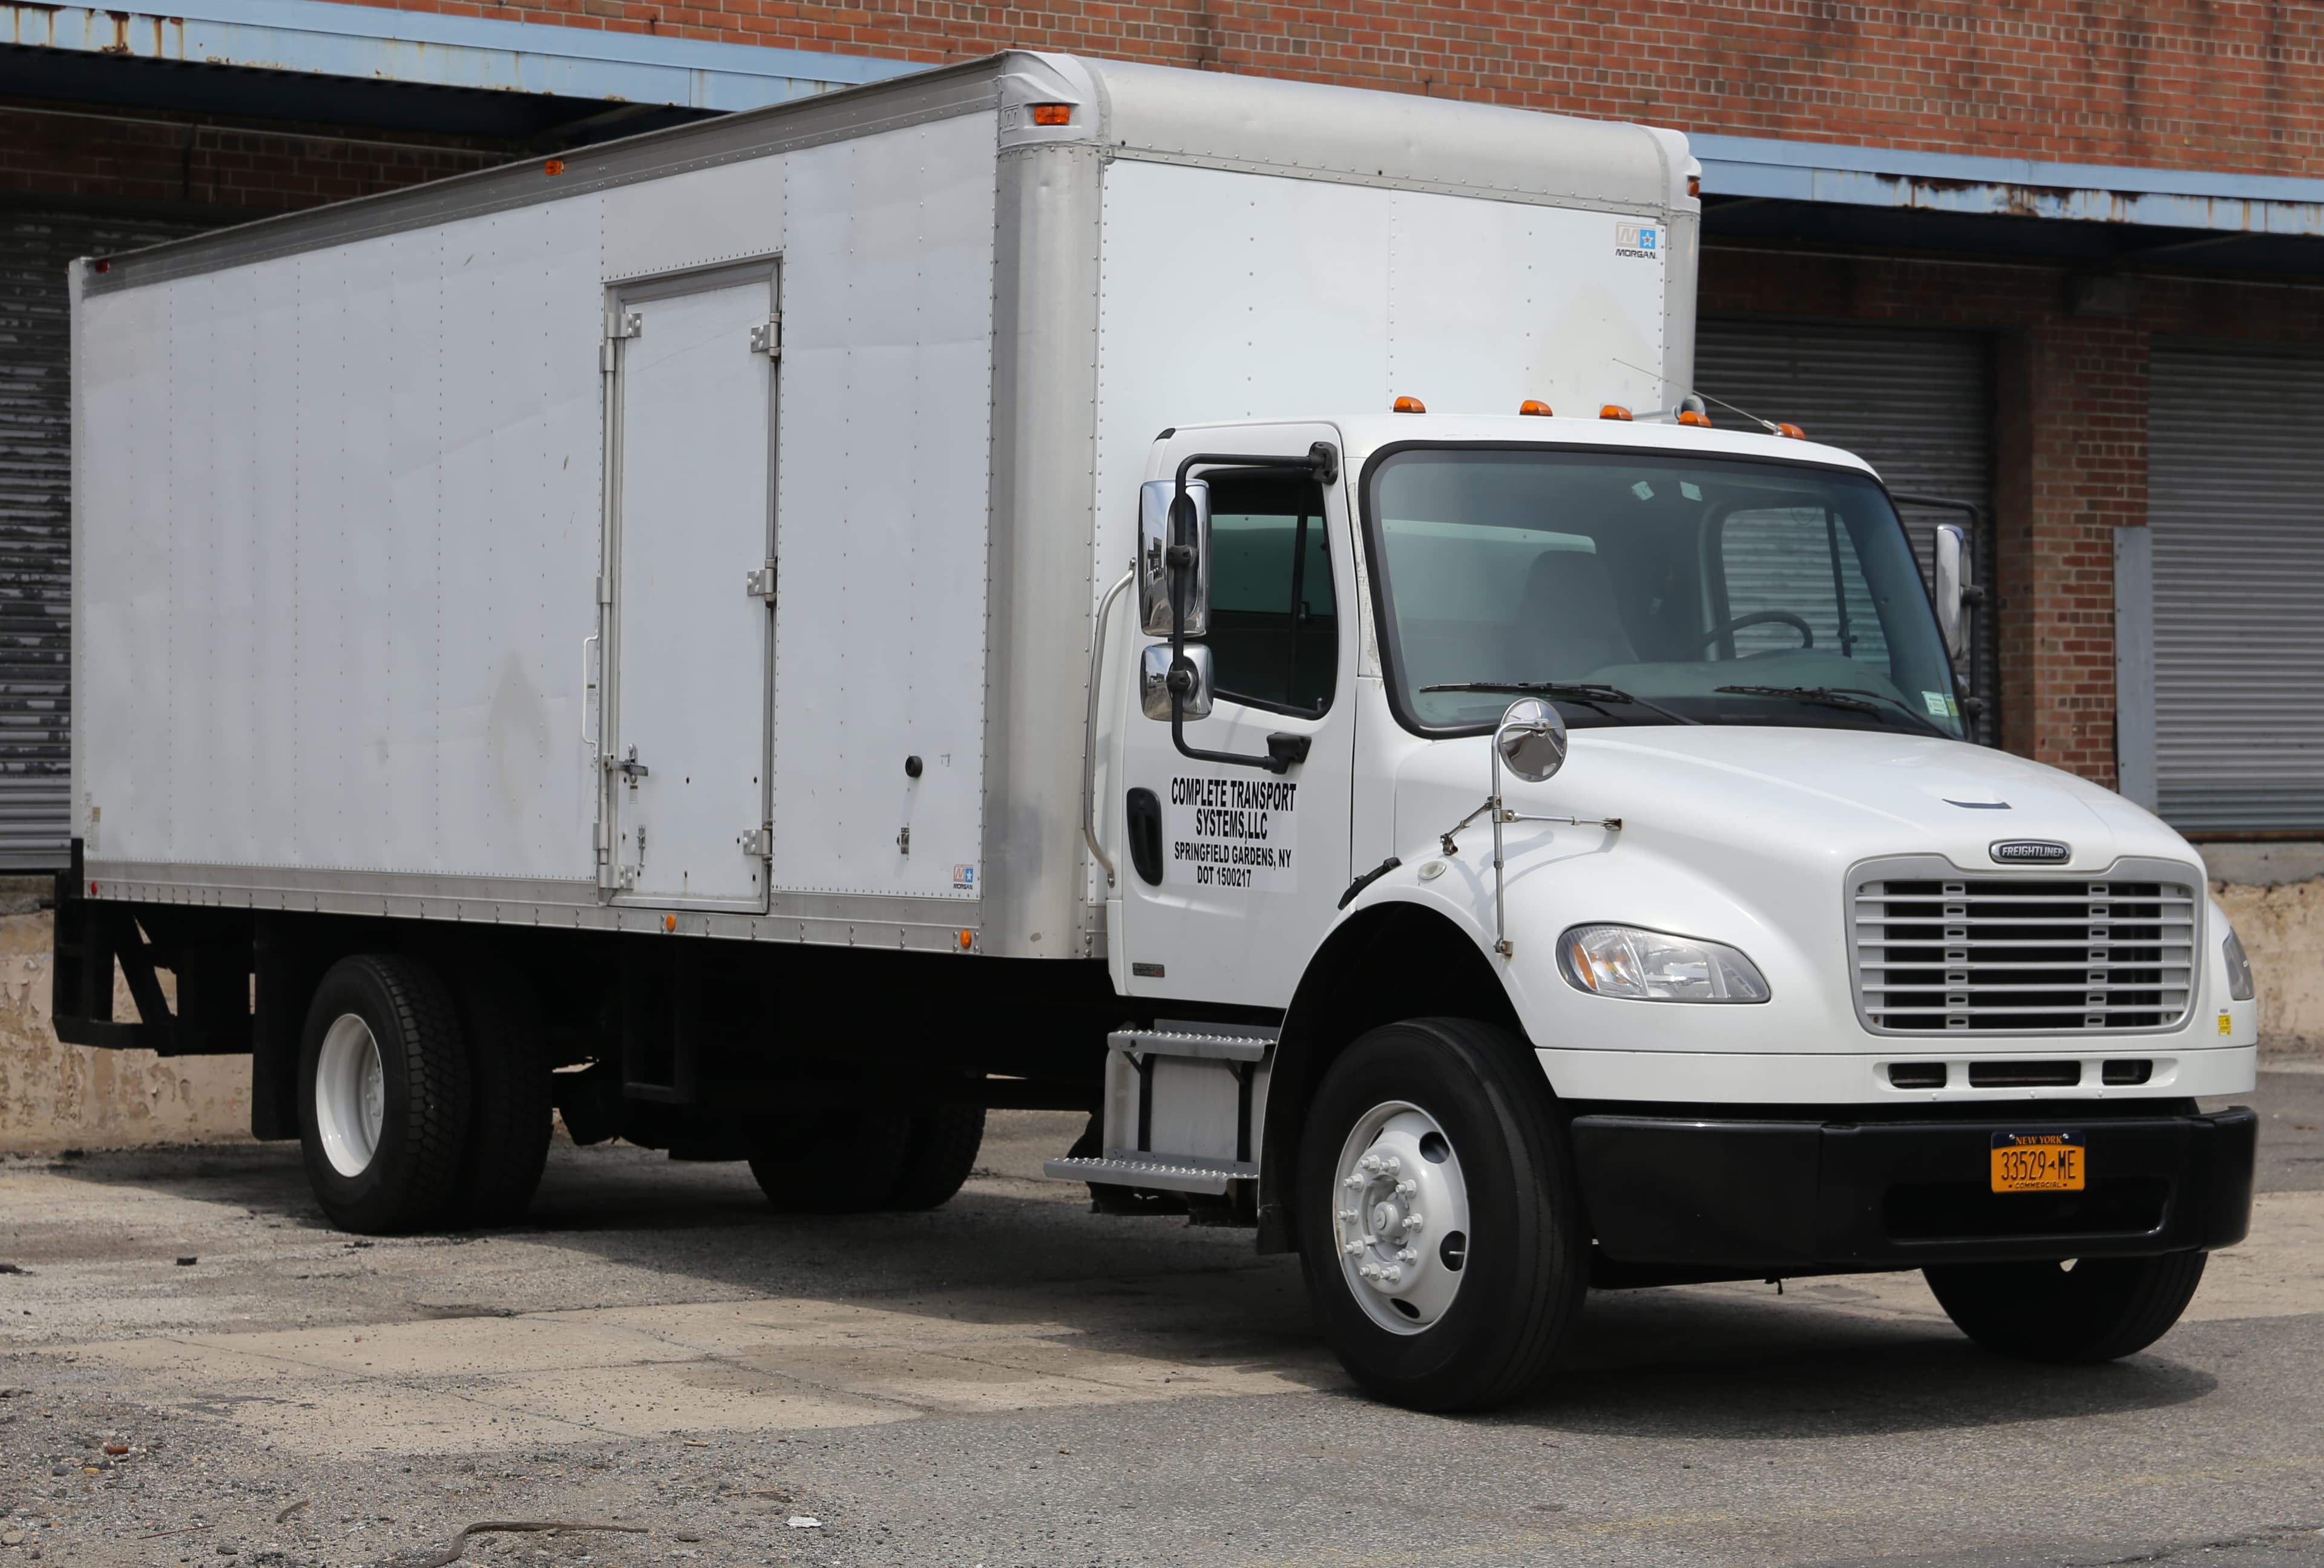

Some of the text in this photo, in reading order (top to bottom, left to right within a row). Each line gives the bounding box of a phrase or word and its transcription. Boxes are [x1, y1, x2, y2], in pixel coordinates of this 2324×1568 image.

[1615, 249, 1656, 259] MORGAN
[1172, 777, 1296, 811] COMPLETE TRANSPORT
[1196, 809, 1267, 844] SYSTEMS,LLC
[1175, 841, 1292, 870] SPRINGFIELD GARDENS, NY
[2002, 846, 2064, 857] FREIGHTLINER
[1198, 865, 1251, 887] DOT 1500217
[2015, 1135, 2063, 1145] NEW YORK
[2001, 1150, 2076, 1180] 33529 ME
